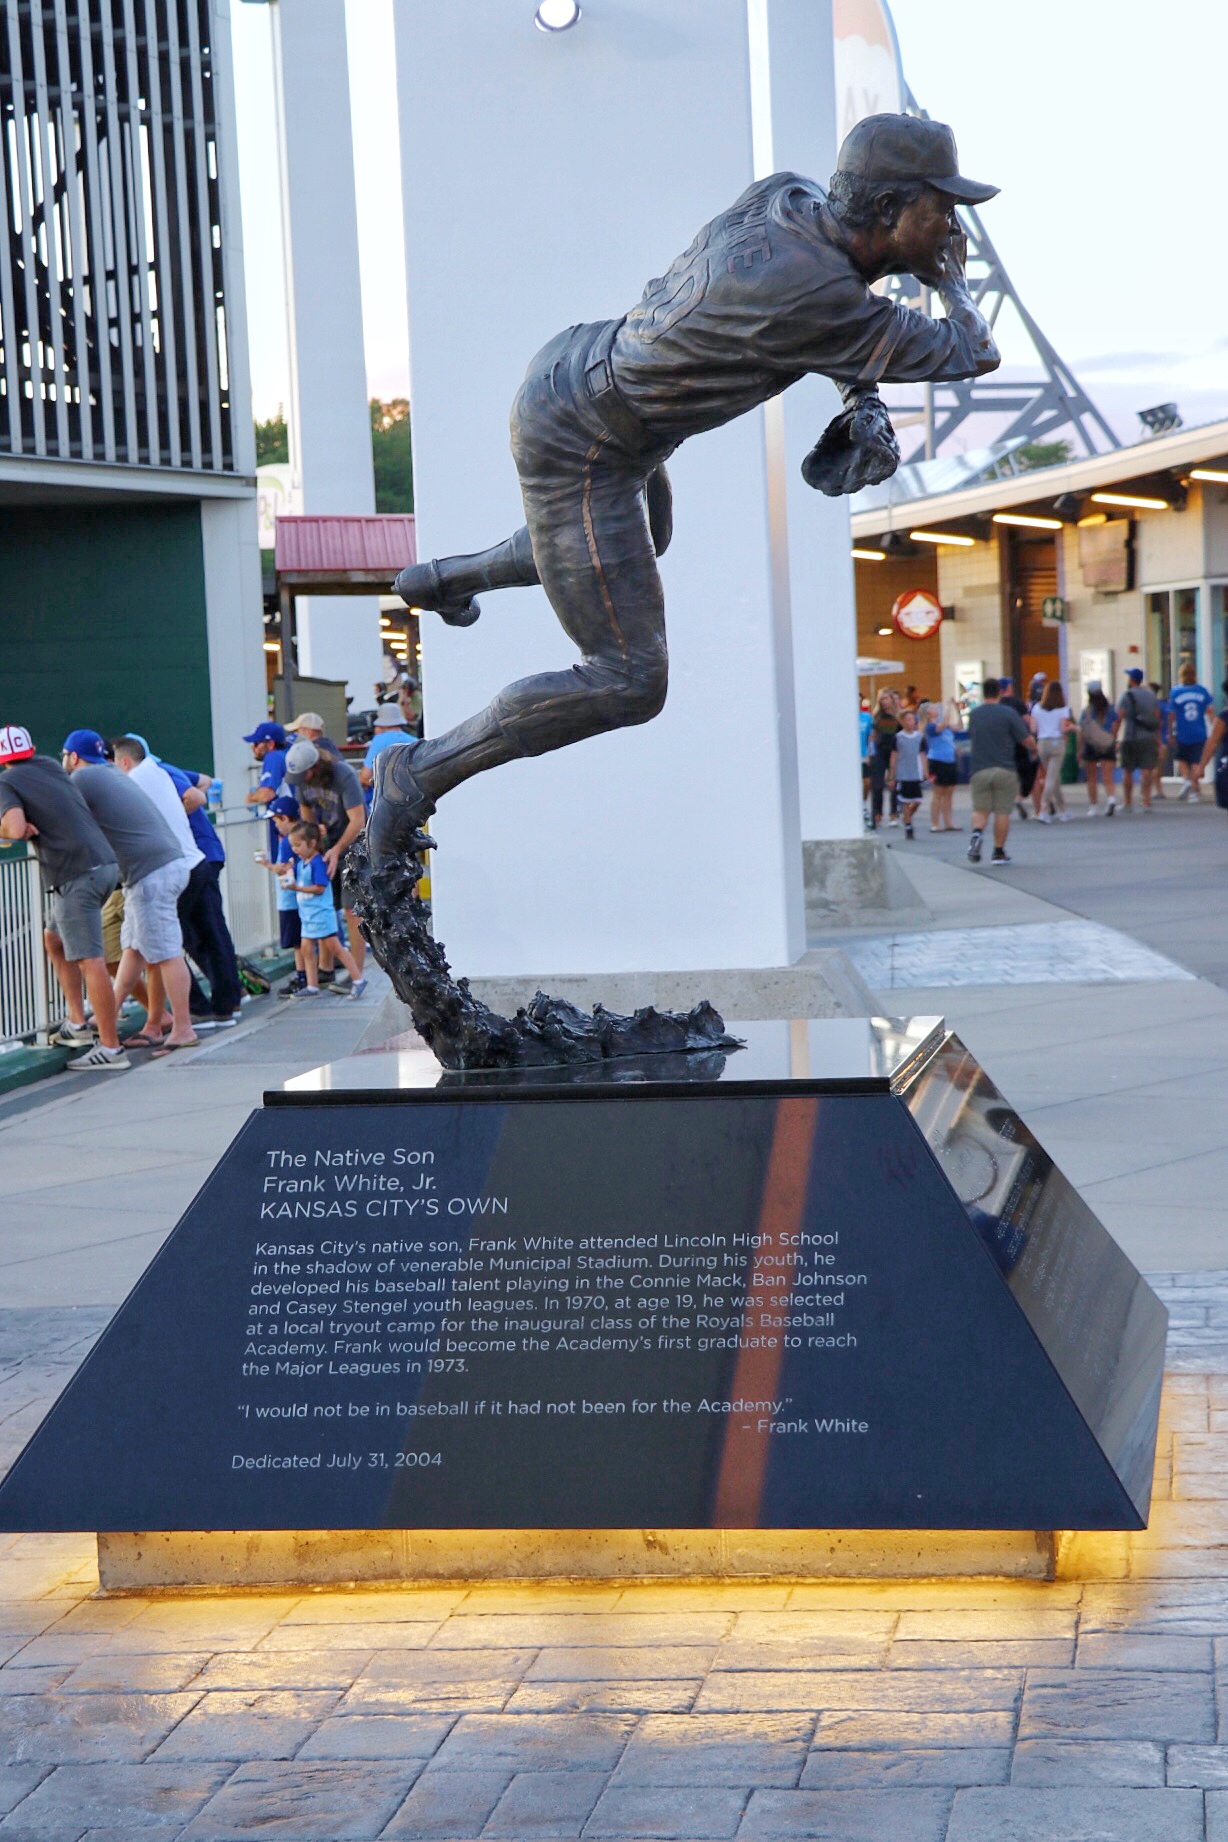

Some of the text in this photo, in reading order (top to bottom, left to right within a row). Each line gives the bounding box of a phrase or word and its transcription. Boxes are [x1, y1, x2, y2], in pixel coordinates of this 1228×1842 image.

[267, 1148, 434, 1169] The Native Son
[263, 1173, 436, 1193] Frank White, Jr.
[261, 1200, 357, 1219] KANSAS
[448, 1197, 508, 1215] OWN
[256, 1243, 314, 1256] Kansas
[372, 1239, 423, 1253] native
[428, 1241, 462, 1253] son,
[469, 1237, 518, 1251] Frank
[522, 1236, 574, 1250] White
[579, 1234, 657, 1249] attended
[664, 1233, 726, 1247] Lincoln
[733, 1232, 772, 1248] High
[779, 1231, 839, 1246] School
[253, 1251, 836, 1277] in the shadow of venerable Municipal Stadium. During his youth, he
[251, 1271, 867, 1296] developed his baseball talent playing in the Connie Mack, Ban Johnson
[249, 1291, 844, 1318] and Casey Stengel youth leagues. In 1970, at age 19, he was selected
[246, 1312, 834, 1336] at a local tryout camp for the inaugural class of the Royals Baseball
[244, 1341, 328, 1357] Academy.
[334, 1339, 382, 1354] Frank
[389, 1338, 440, 1353] would
[446, 1338, 516, 1352] become
[522, 1337, 551, 1351] the
[658, 1335, 692, 1349] first
[698, 1334, 777, 1351] graduate
[784, 1334, 801, 1347] to
[808, 1332, 857, 1347] reach
[242, 1359, 468, 1377] the Major Leagues in 1973.
[256, 1403, 308, 1418] would
[314, 1404, 343, 1417] not
[348, 1402, 370, 1416] be
[376, 1402, 390, 1416] in
[396, 1401, 468, 1416] baseball
[475, 1400, 486, 1415] if
[491, 1401, 503, 1415] it
[508, 1400, 541, 1415] had
[547, 1401, 576, 1415] not
[582, 1400, 625, 1414] been
[632, 1399, 657, 1413] for
[662, 1398, 691, 1413] the
[757, 1419, 808, 1433] Frank
[815, 1418, 869, 1433] White
[232, 1452, 442, 1470] Dedicated July 31, 2004
